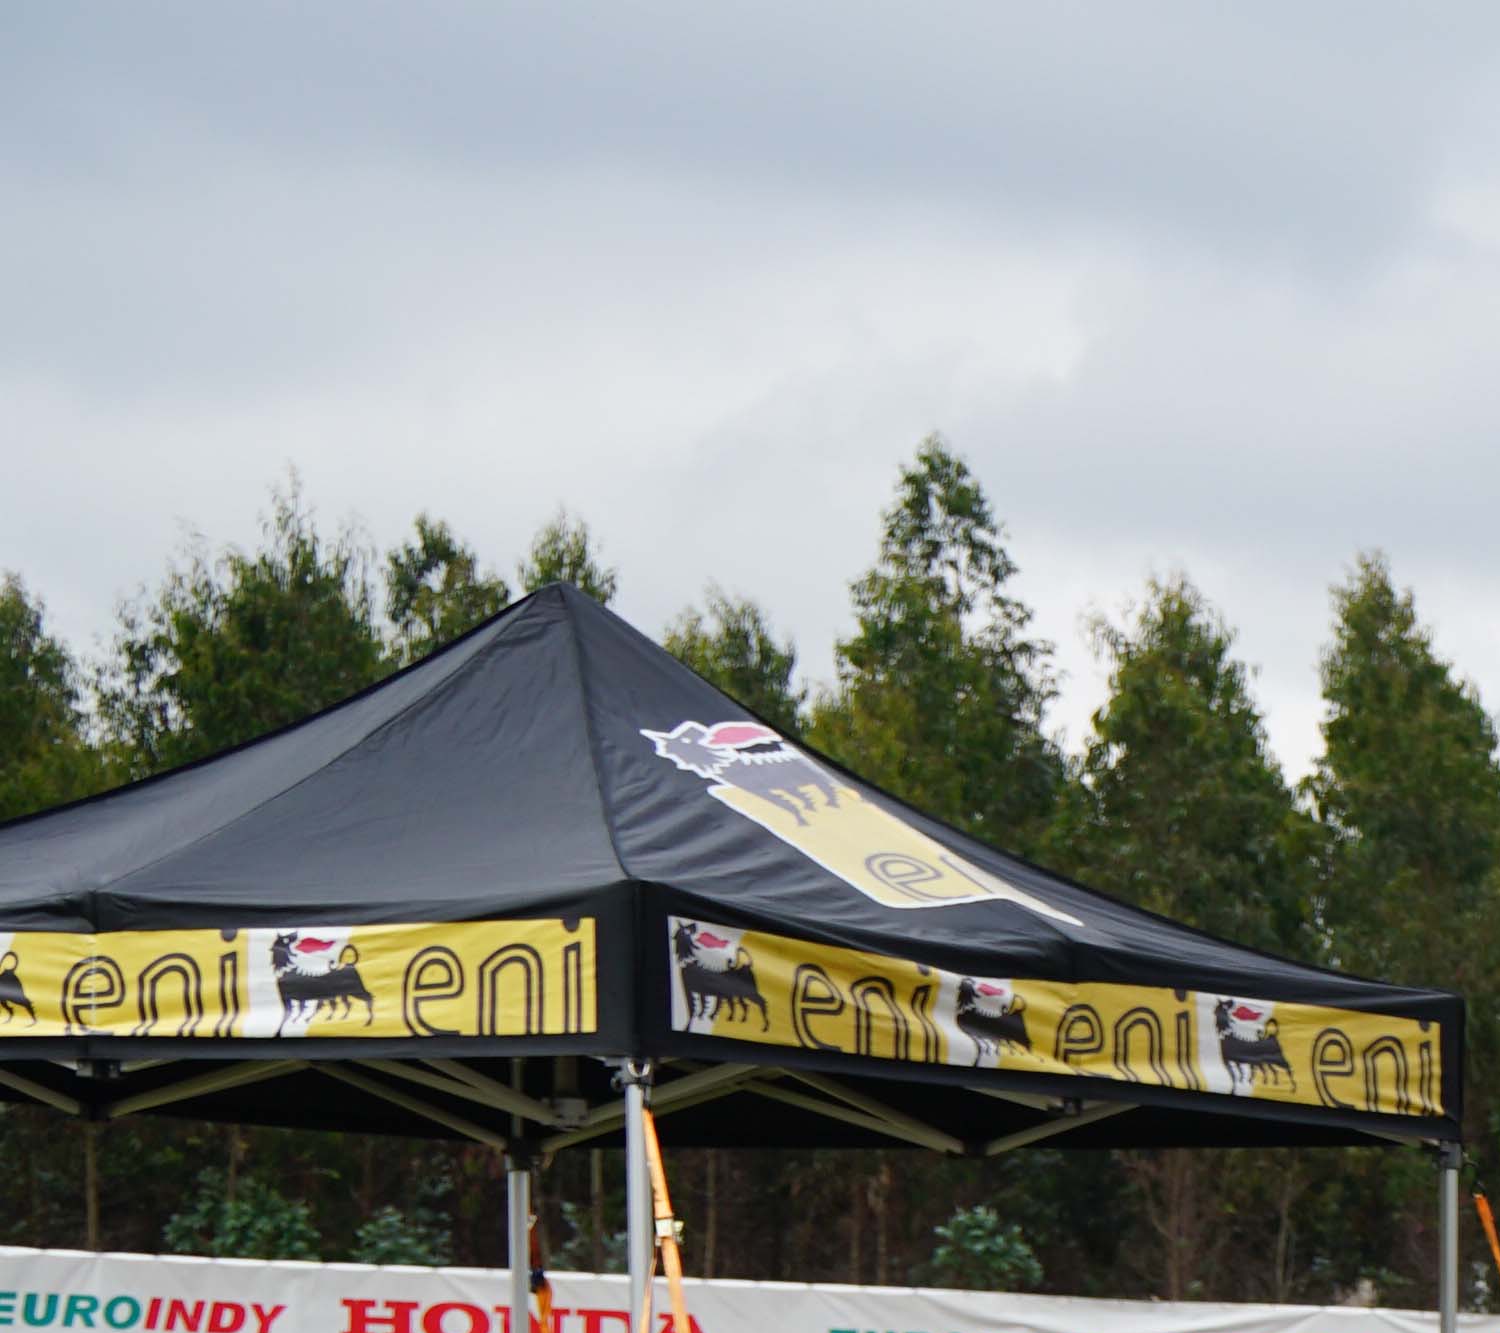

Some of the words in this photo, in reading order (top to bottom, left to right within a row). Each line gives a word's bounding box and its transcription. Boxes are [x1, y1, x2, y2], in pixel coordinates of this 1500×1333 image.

[61, 928, 242, 1037] eni
[402, 917, 583, 1036] eni
[791, 963, 941, 1062] eni
[1056, 989, 1199, 1089] eni
[1312, 1022, 1445, 1117] eni
